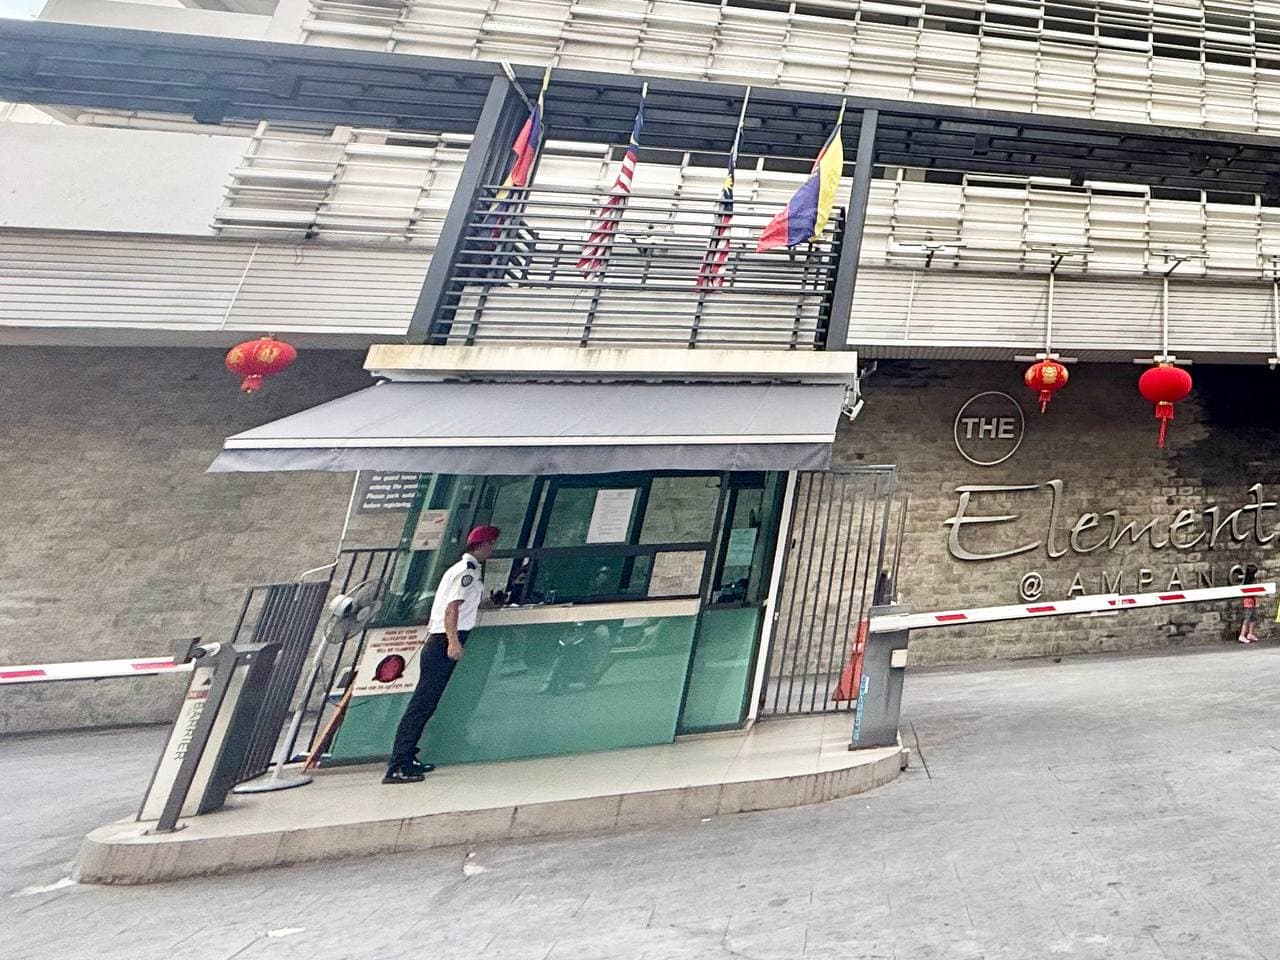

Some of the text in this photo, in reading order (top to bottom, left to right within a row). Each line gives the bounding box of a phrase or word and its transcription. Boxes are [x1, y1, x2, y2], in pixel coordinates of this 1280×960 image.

[961, 417, 1016, 440] THE
[1019, 564, 1252, 601] @ AMPANG
[173, 702, 204, 761] BARRIER
